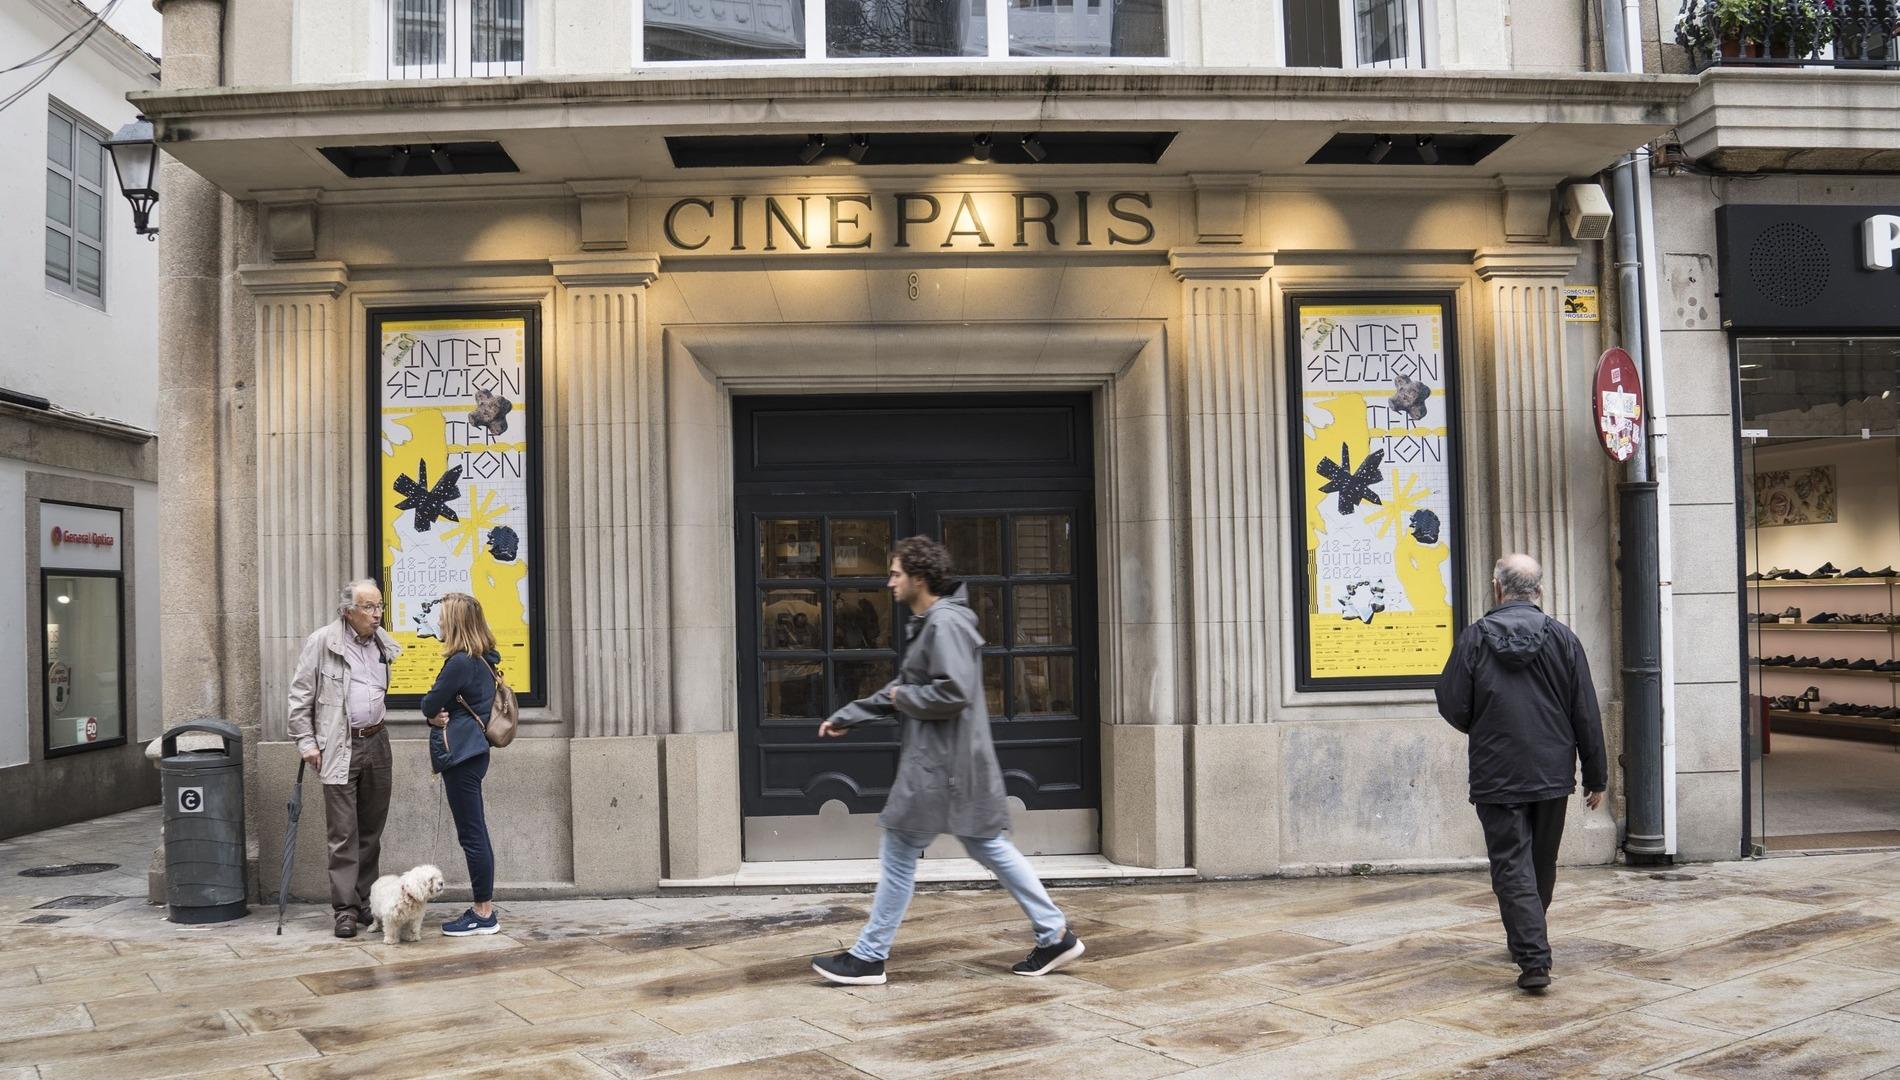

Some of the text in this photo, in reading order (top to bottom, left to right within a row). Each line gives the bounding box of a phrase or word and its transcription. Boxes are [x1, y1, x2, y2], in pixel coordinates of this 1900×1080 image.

[663, 190, 1155, 250] CINE PARIS
[907, 271, 920, 301] 8
[1324, 324, 1418, 353] INTER
[404, 338, 502, 369] INTER
[63, 530, 91, 544] General
[1320, 539, 1372, 553] 18-23
[396, 556, 448, 570] 18-23
[1321, 552, 1393, 567] OUTUBRO
[396, 569, 469, 584] OUTUBRO
[1321, 566, 1363, 580] 2022
[396, 584, 438, 597] 2022
[87, 722, 98, 735] 50
